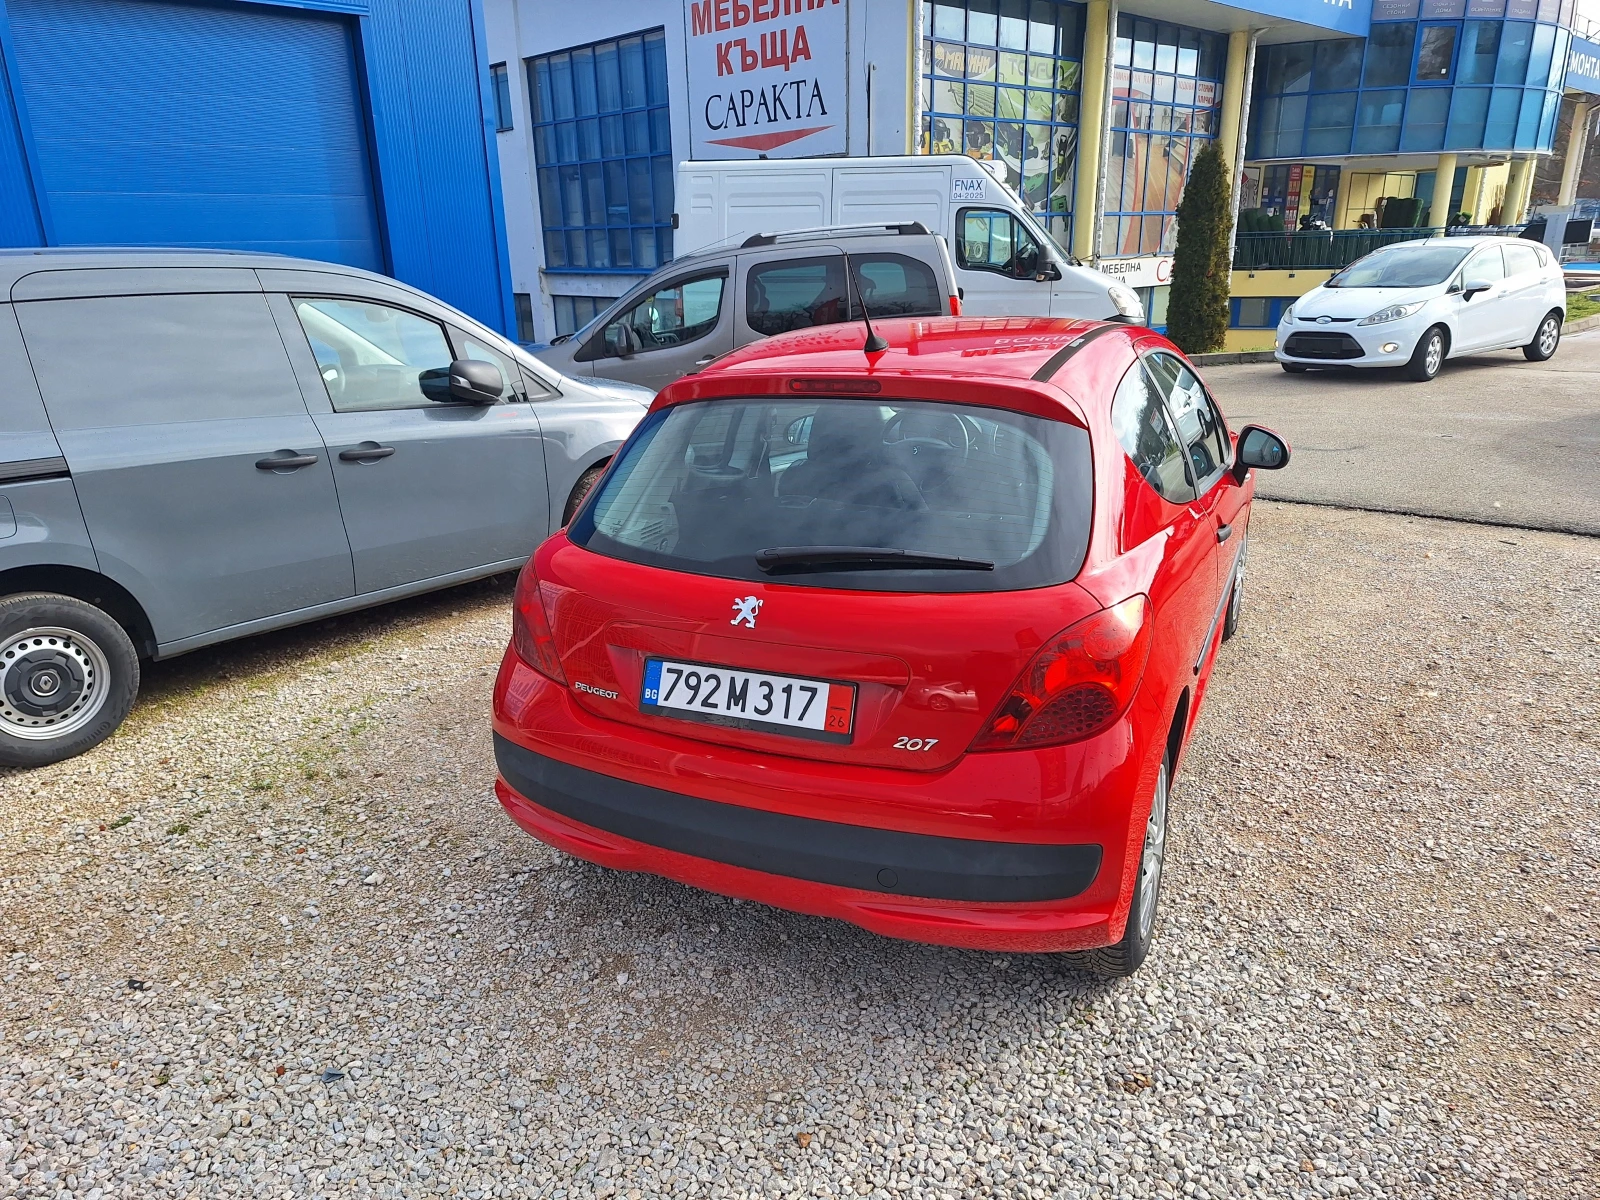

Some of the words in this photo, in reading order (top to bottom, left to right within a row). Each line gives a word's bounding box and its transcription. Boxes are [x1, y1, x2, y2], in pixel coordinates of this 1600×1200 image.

[691, 0, 841, 37] МЕБЕЛ
[716, 25, 812, 77] КЪЩА
[1567, 50, 1600, 80] МОНТА
[705, 77, 828, 131] САРАКТА
[954, 179, 983, 191] FNAX
[1101, 262, 1142, 275] МЕБЕЛНА
[574, 682, 619, 700] PEUGEOT
[645, 687, 658, 701] BG
[829, 716, 845, 728] 26
[893, 736, 940, 752] 207
